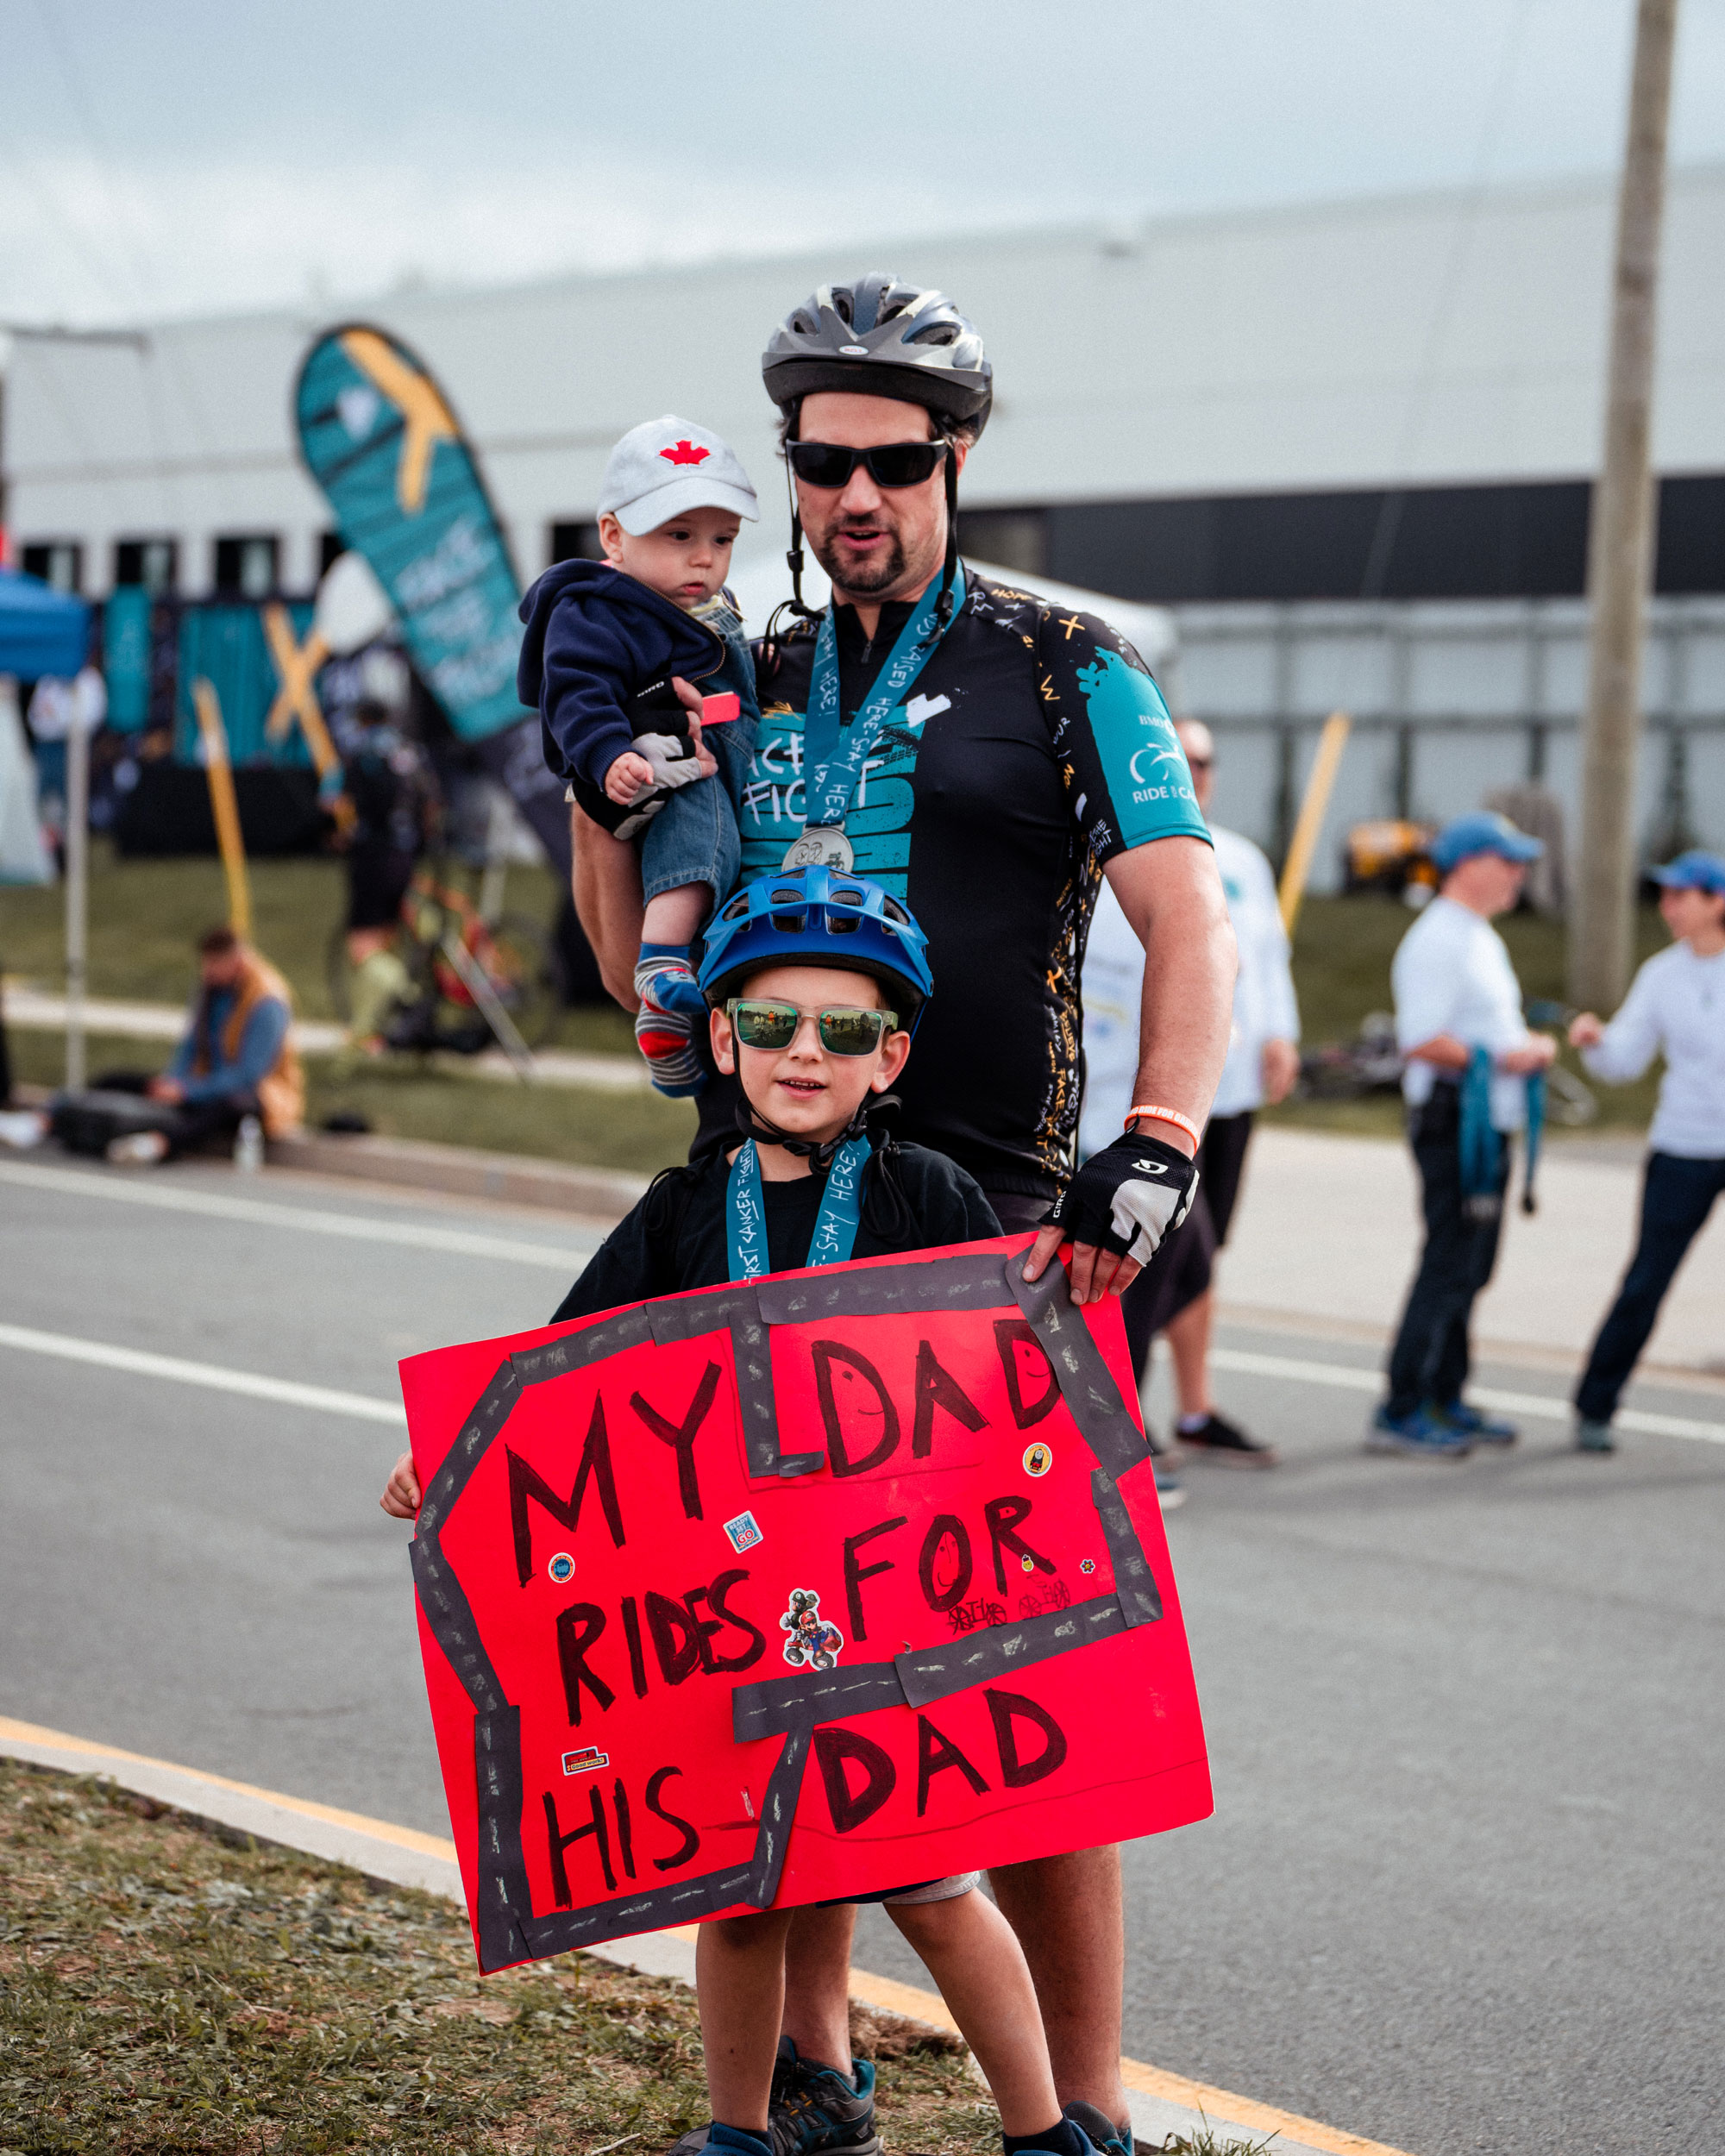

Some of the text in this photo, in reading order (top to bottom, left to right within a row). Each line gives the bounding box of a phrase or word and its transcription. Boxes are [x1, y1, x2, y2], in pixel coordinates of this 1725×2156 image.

[1132, 786, 1170, 804] RIDE
[1157, 1107, 1174, 1119] FOR
[829, 1142, 861, 1200] HERE!
[737, 1188, 760, 1244] CANCER
[1052, 1191, 1067, 1218] GIRO
[505, 1319, 1062, 1589] MY DAD
[737, 1529, 756, 1545] GO
[556, 1495, 1055, 1727] RIDES FOR
[571, 1761, 586, 1770] Good
[543, 1688, 1068, 1908] HIS DAD
